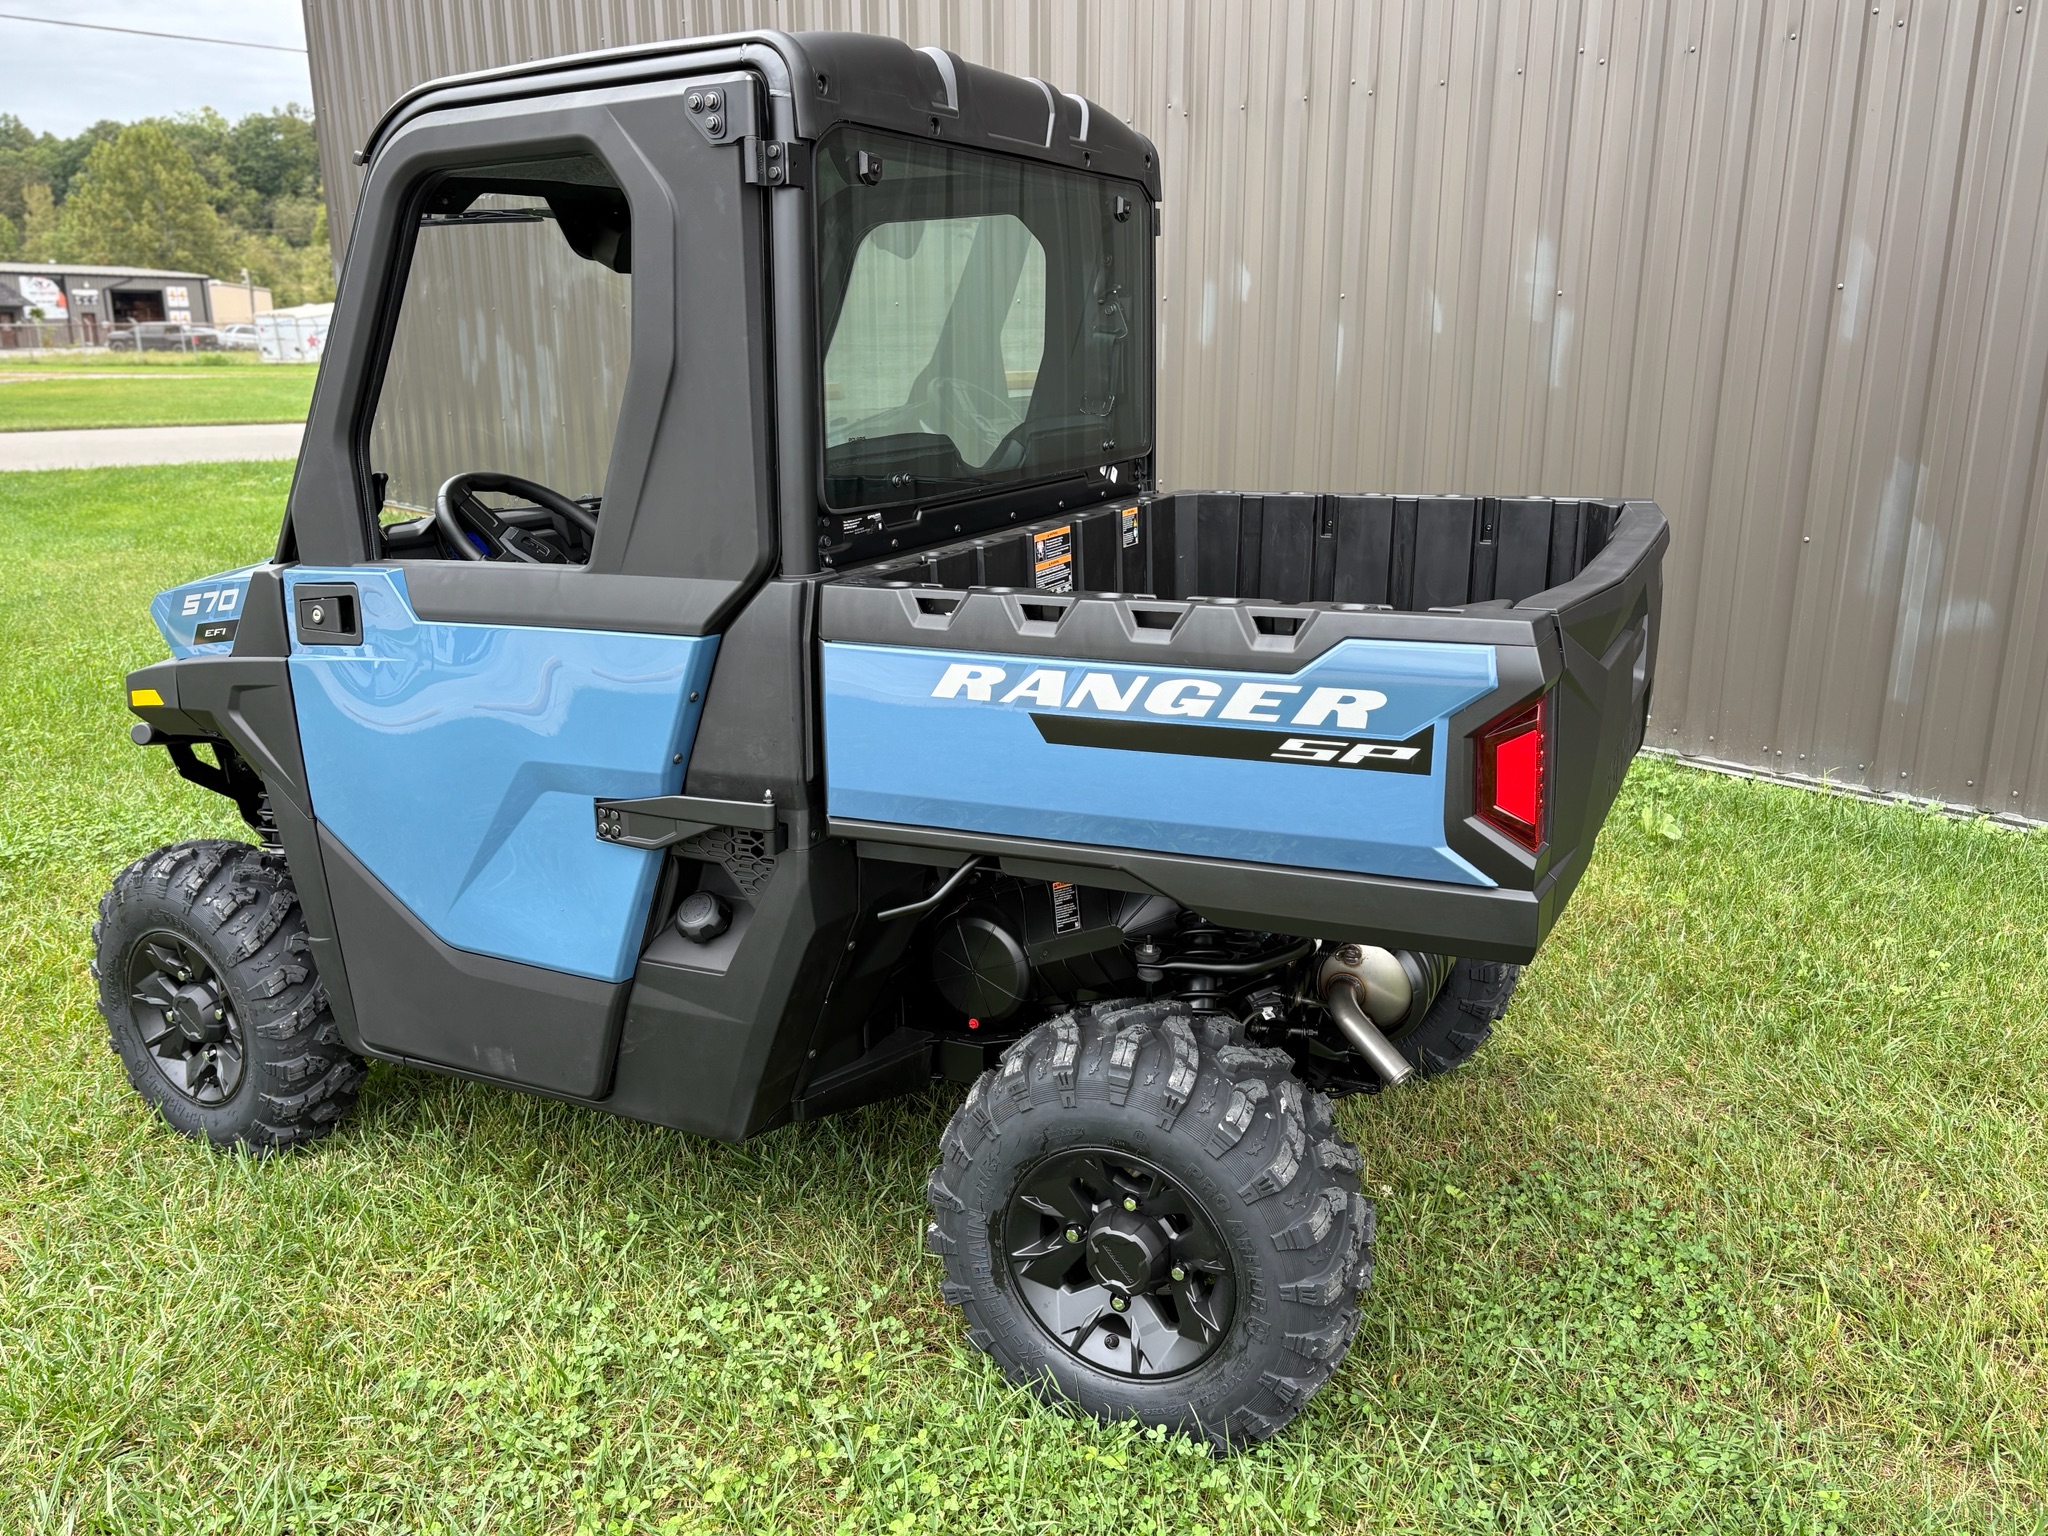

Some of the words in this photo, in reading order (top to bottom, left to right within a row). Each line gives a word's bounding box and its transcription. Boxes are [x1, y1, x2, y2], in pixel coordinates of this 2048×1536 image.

[181, 588, 240, 616] 570
[204, 628, 227, 637] EFI
[930, 663, 1389, 730] RANGER
[1270, 738, 1421, 765] SP
[1184, 1162, 1232, 1213] PRO
[1226, 1218, 1269, 1316] ARMOR
[967, 1207, 1046, 1367] X-TERRAIN
